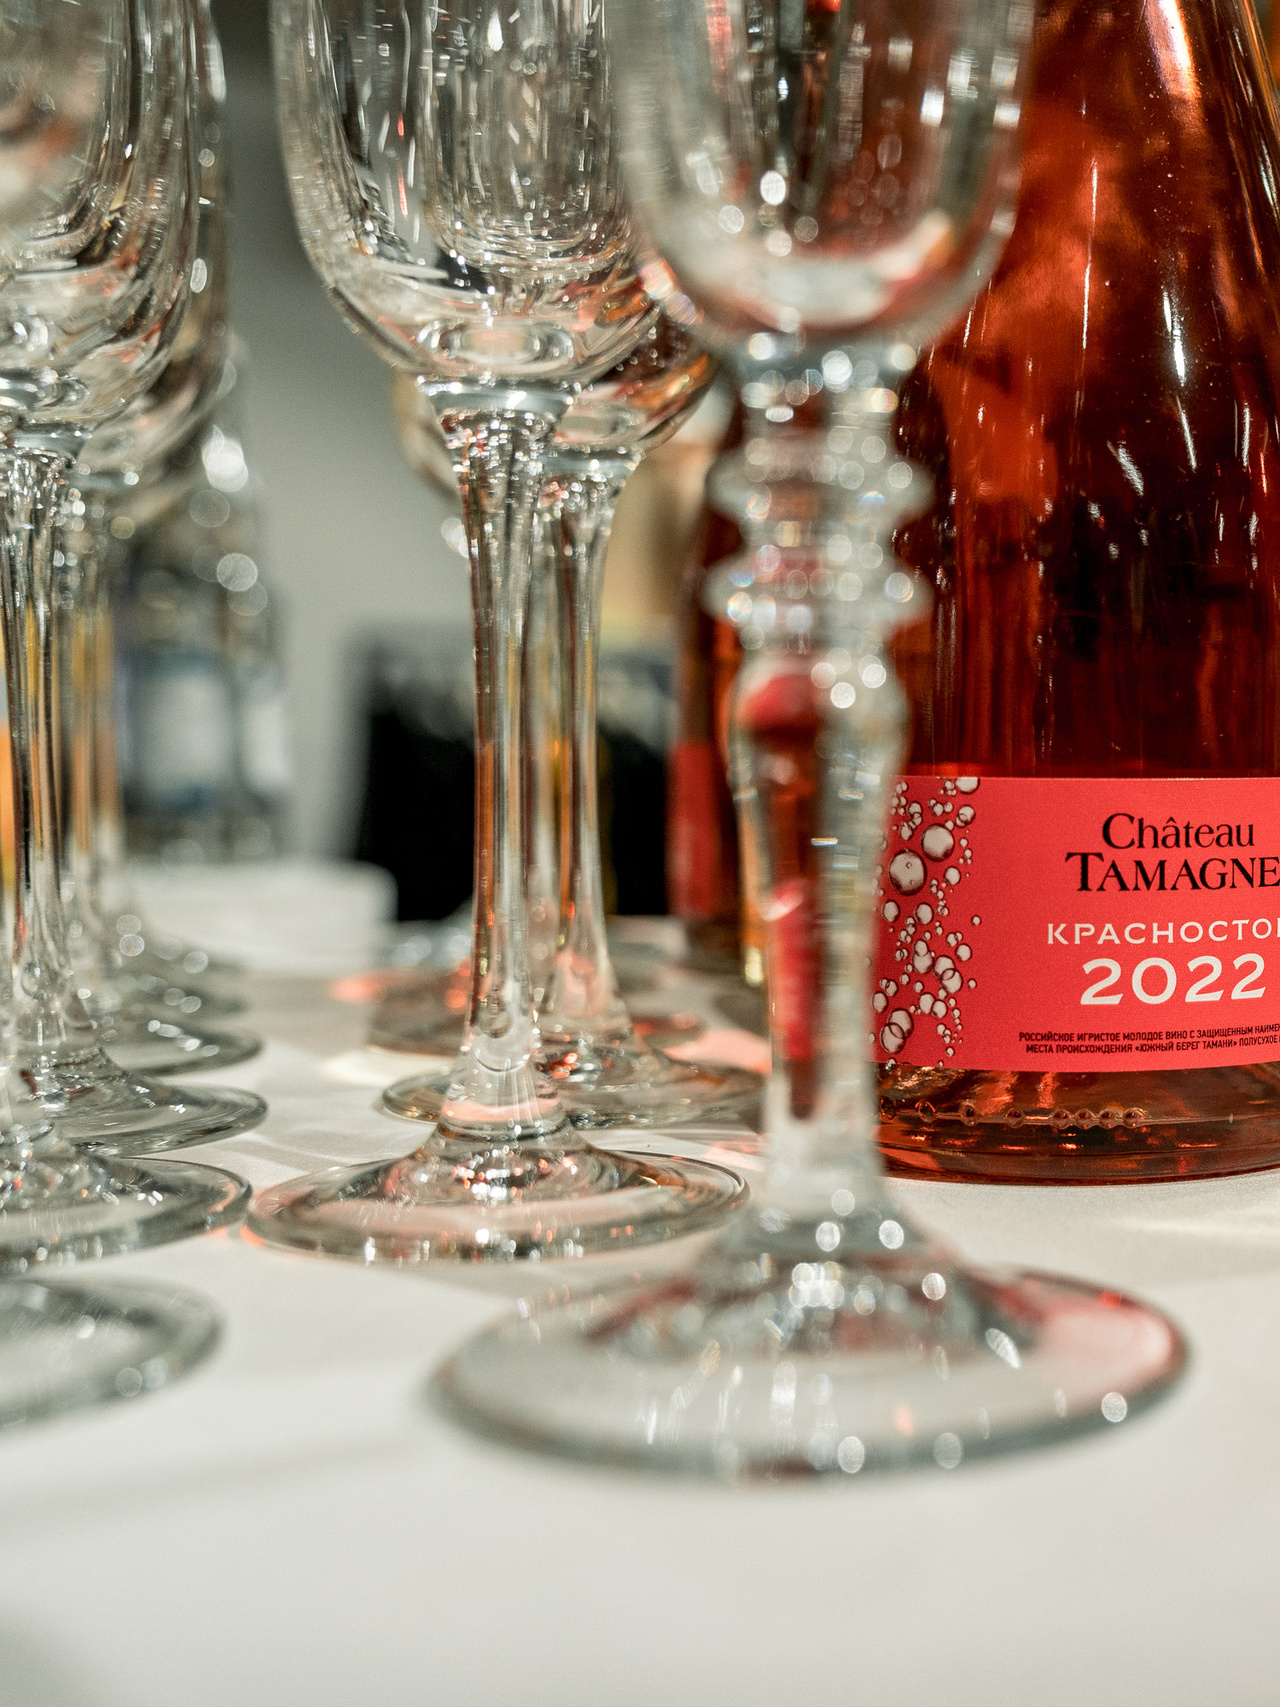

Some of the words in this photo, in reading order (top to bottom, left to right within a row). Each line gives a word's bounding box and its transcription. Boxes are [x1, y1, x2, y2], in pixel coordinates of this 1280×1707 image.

[1102, 813, 1255, 849] Château
[1080, 952, 1267, 1005] 2022
[1019, 1031, 1075, 1042] РОССИЙСКОЕ
[1076, 1032, 1121, 1042] ИГРИСТОЕ
[1122, 1031, 1164, 1042] МОЛОДОЕ
[1165, 1030, 1188, 1040] ВИНО
[1189, 1029, 1196, 1039] С
[1196, 1026, 1254, 1039] ЗАЩИЩЕННЫМ
[1026, 1043, 1054, 1054] МЕСТА
[1055, 1043, 1133, 1054] ПРОИСХОЖДЕНИЯ
[1135, 1040, 1174, 1053] «ЮЖНЫЙ
[1175, 1040, 1201, 1051] БЕРЕГ
[1202, 1038, 1238, 1050] ТАМАНИ»
[1238, 1034, 1278, 1047] ПОЛУСУХОЕ
